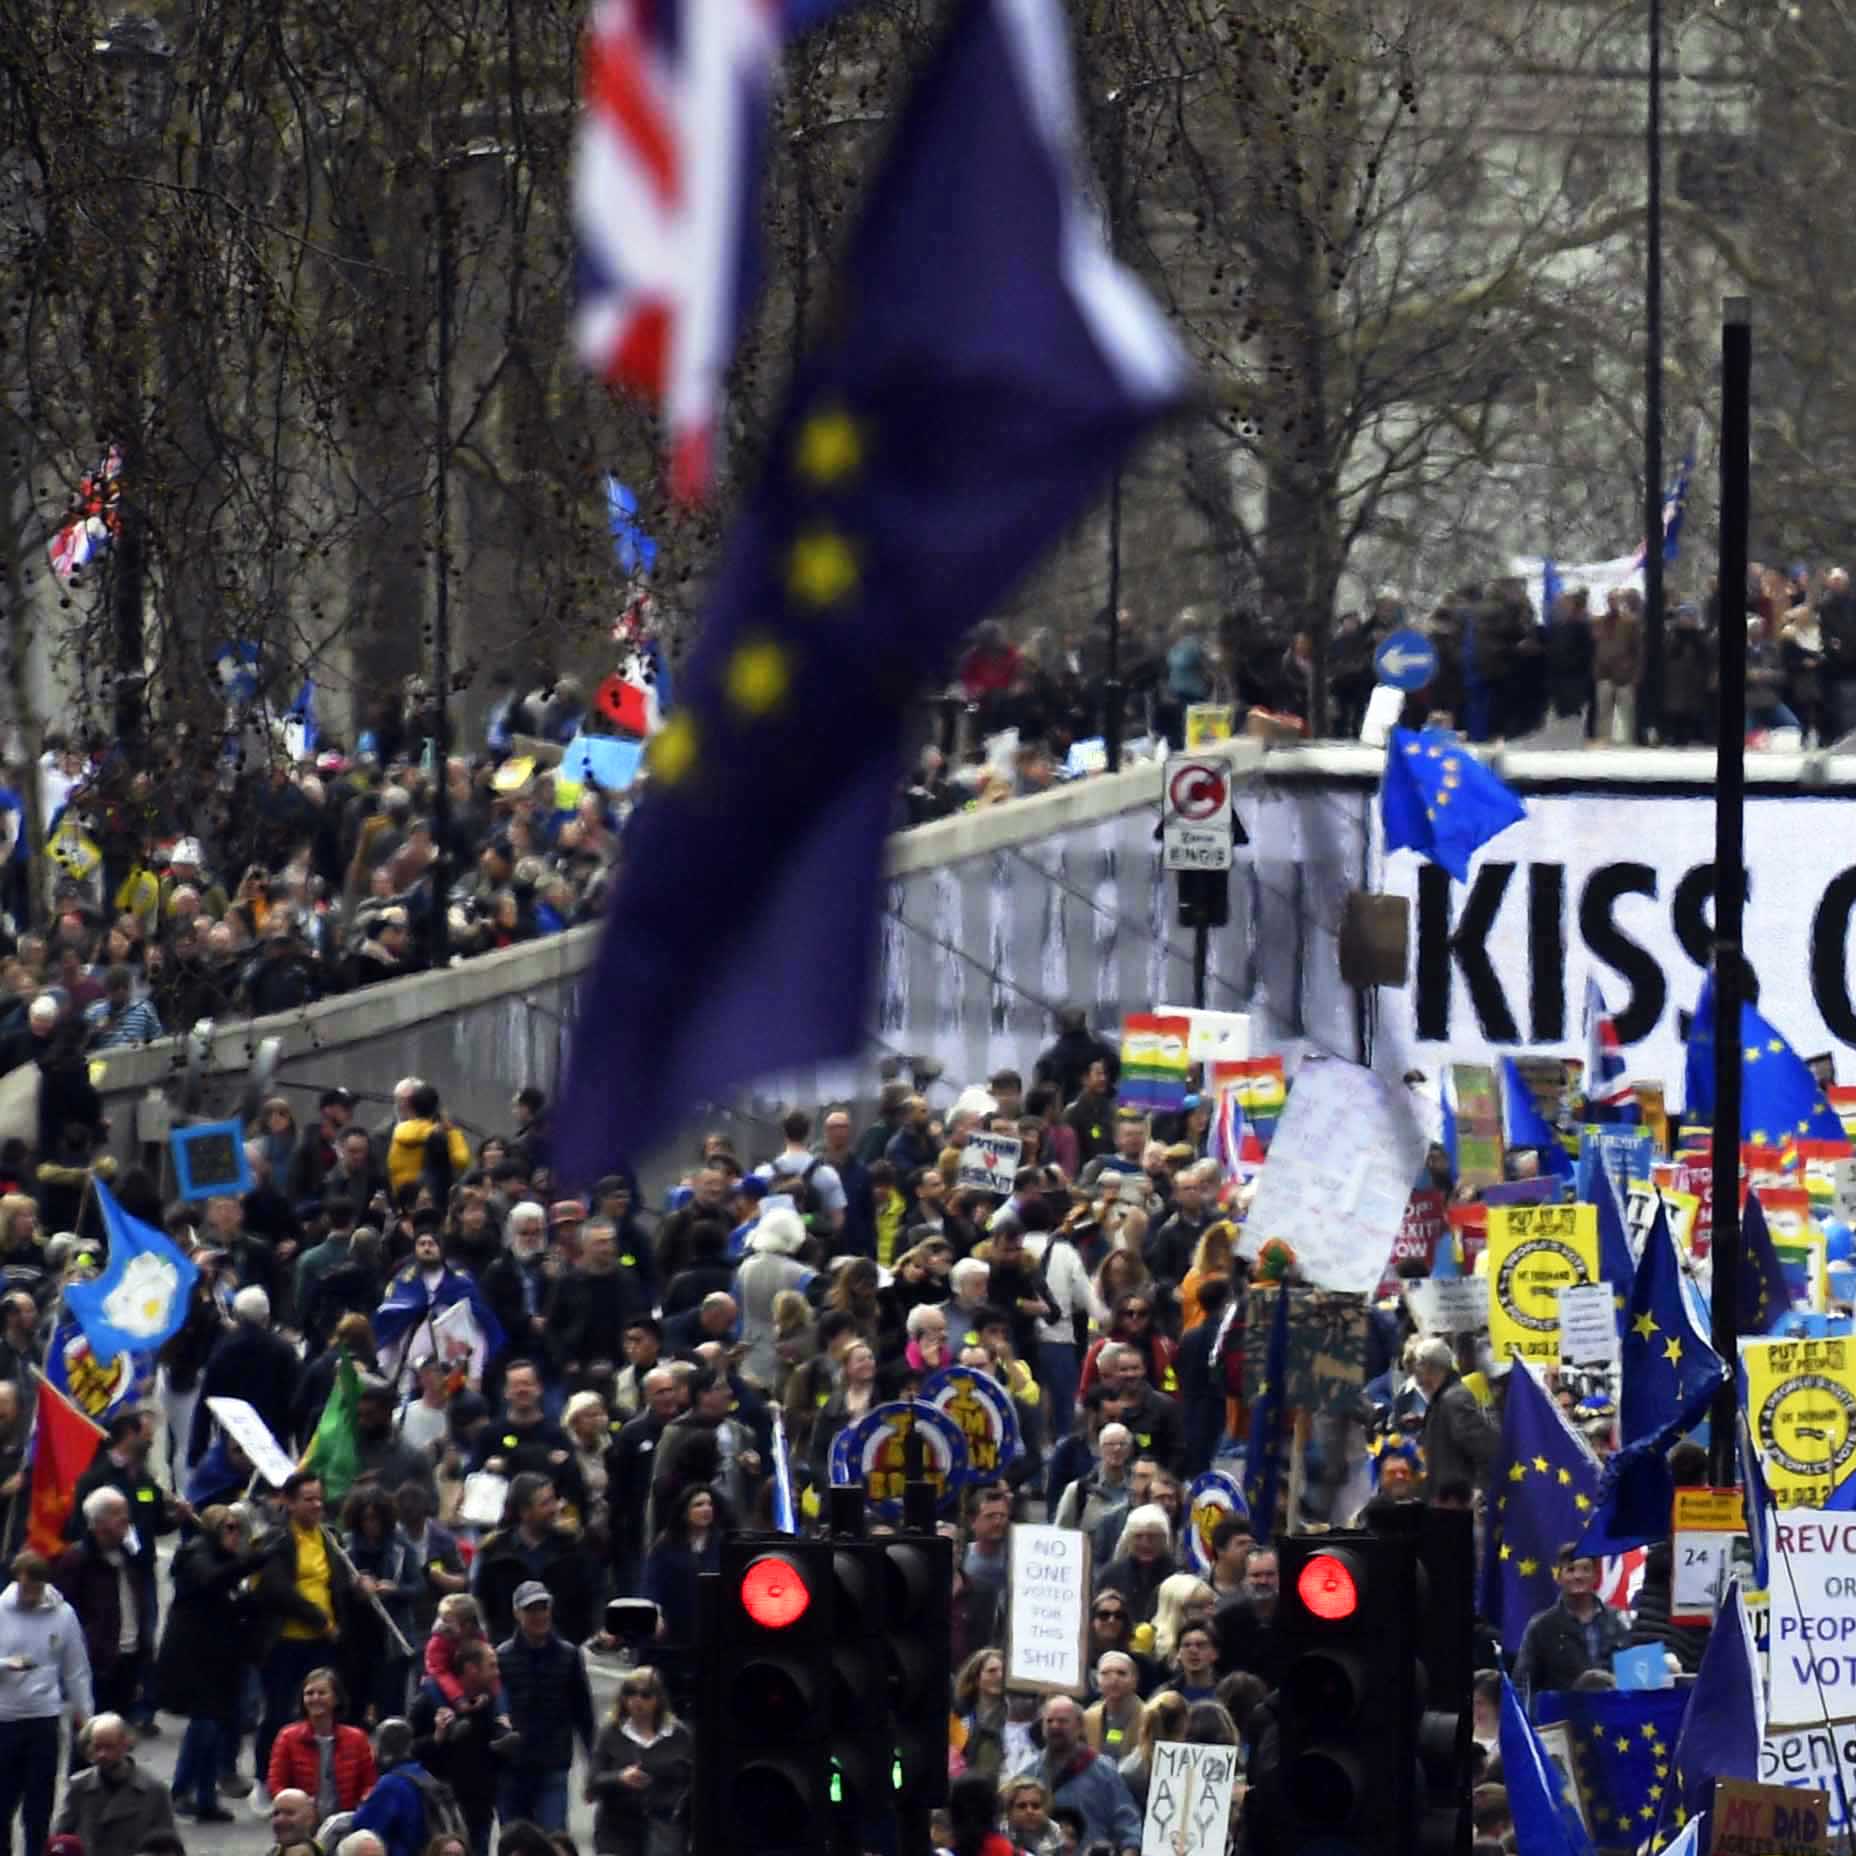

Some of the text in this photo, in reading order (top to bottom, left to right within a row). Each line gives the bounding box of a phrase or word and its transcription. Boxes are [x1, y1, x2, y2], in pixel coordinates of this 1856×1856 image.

[1415, 862, 1760, 1046] KISS
[1034, 1539, 1067, 1561] NO
[1026, 1564, 1071, 1585] ONE
[1825, 1577, 1856, 1598] OR
[1029, 1624, 1064, 1641] THIS
[1023, 1647, 1068, 1670] SHIT
